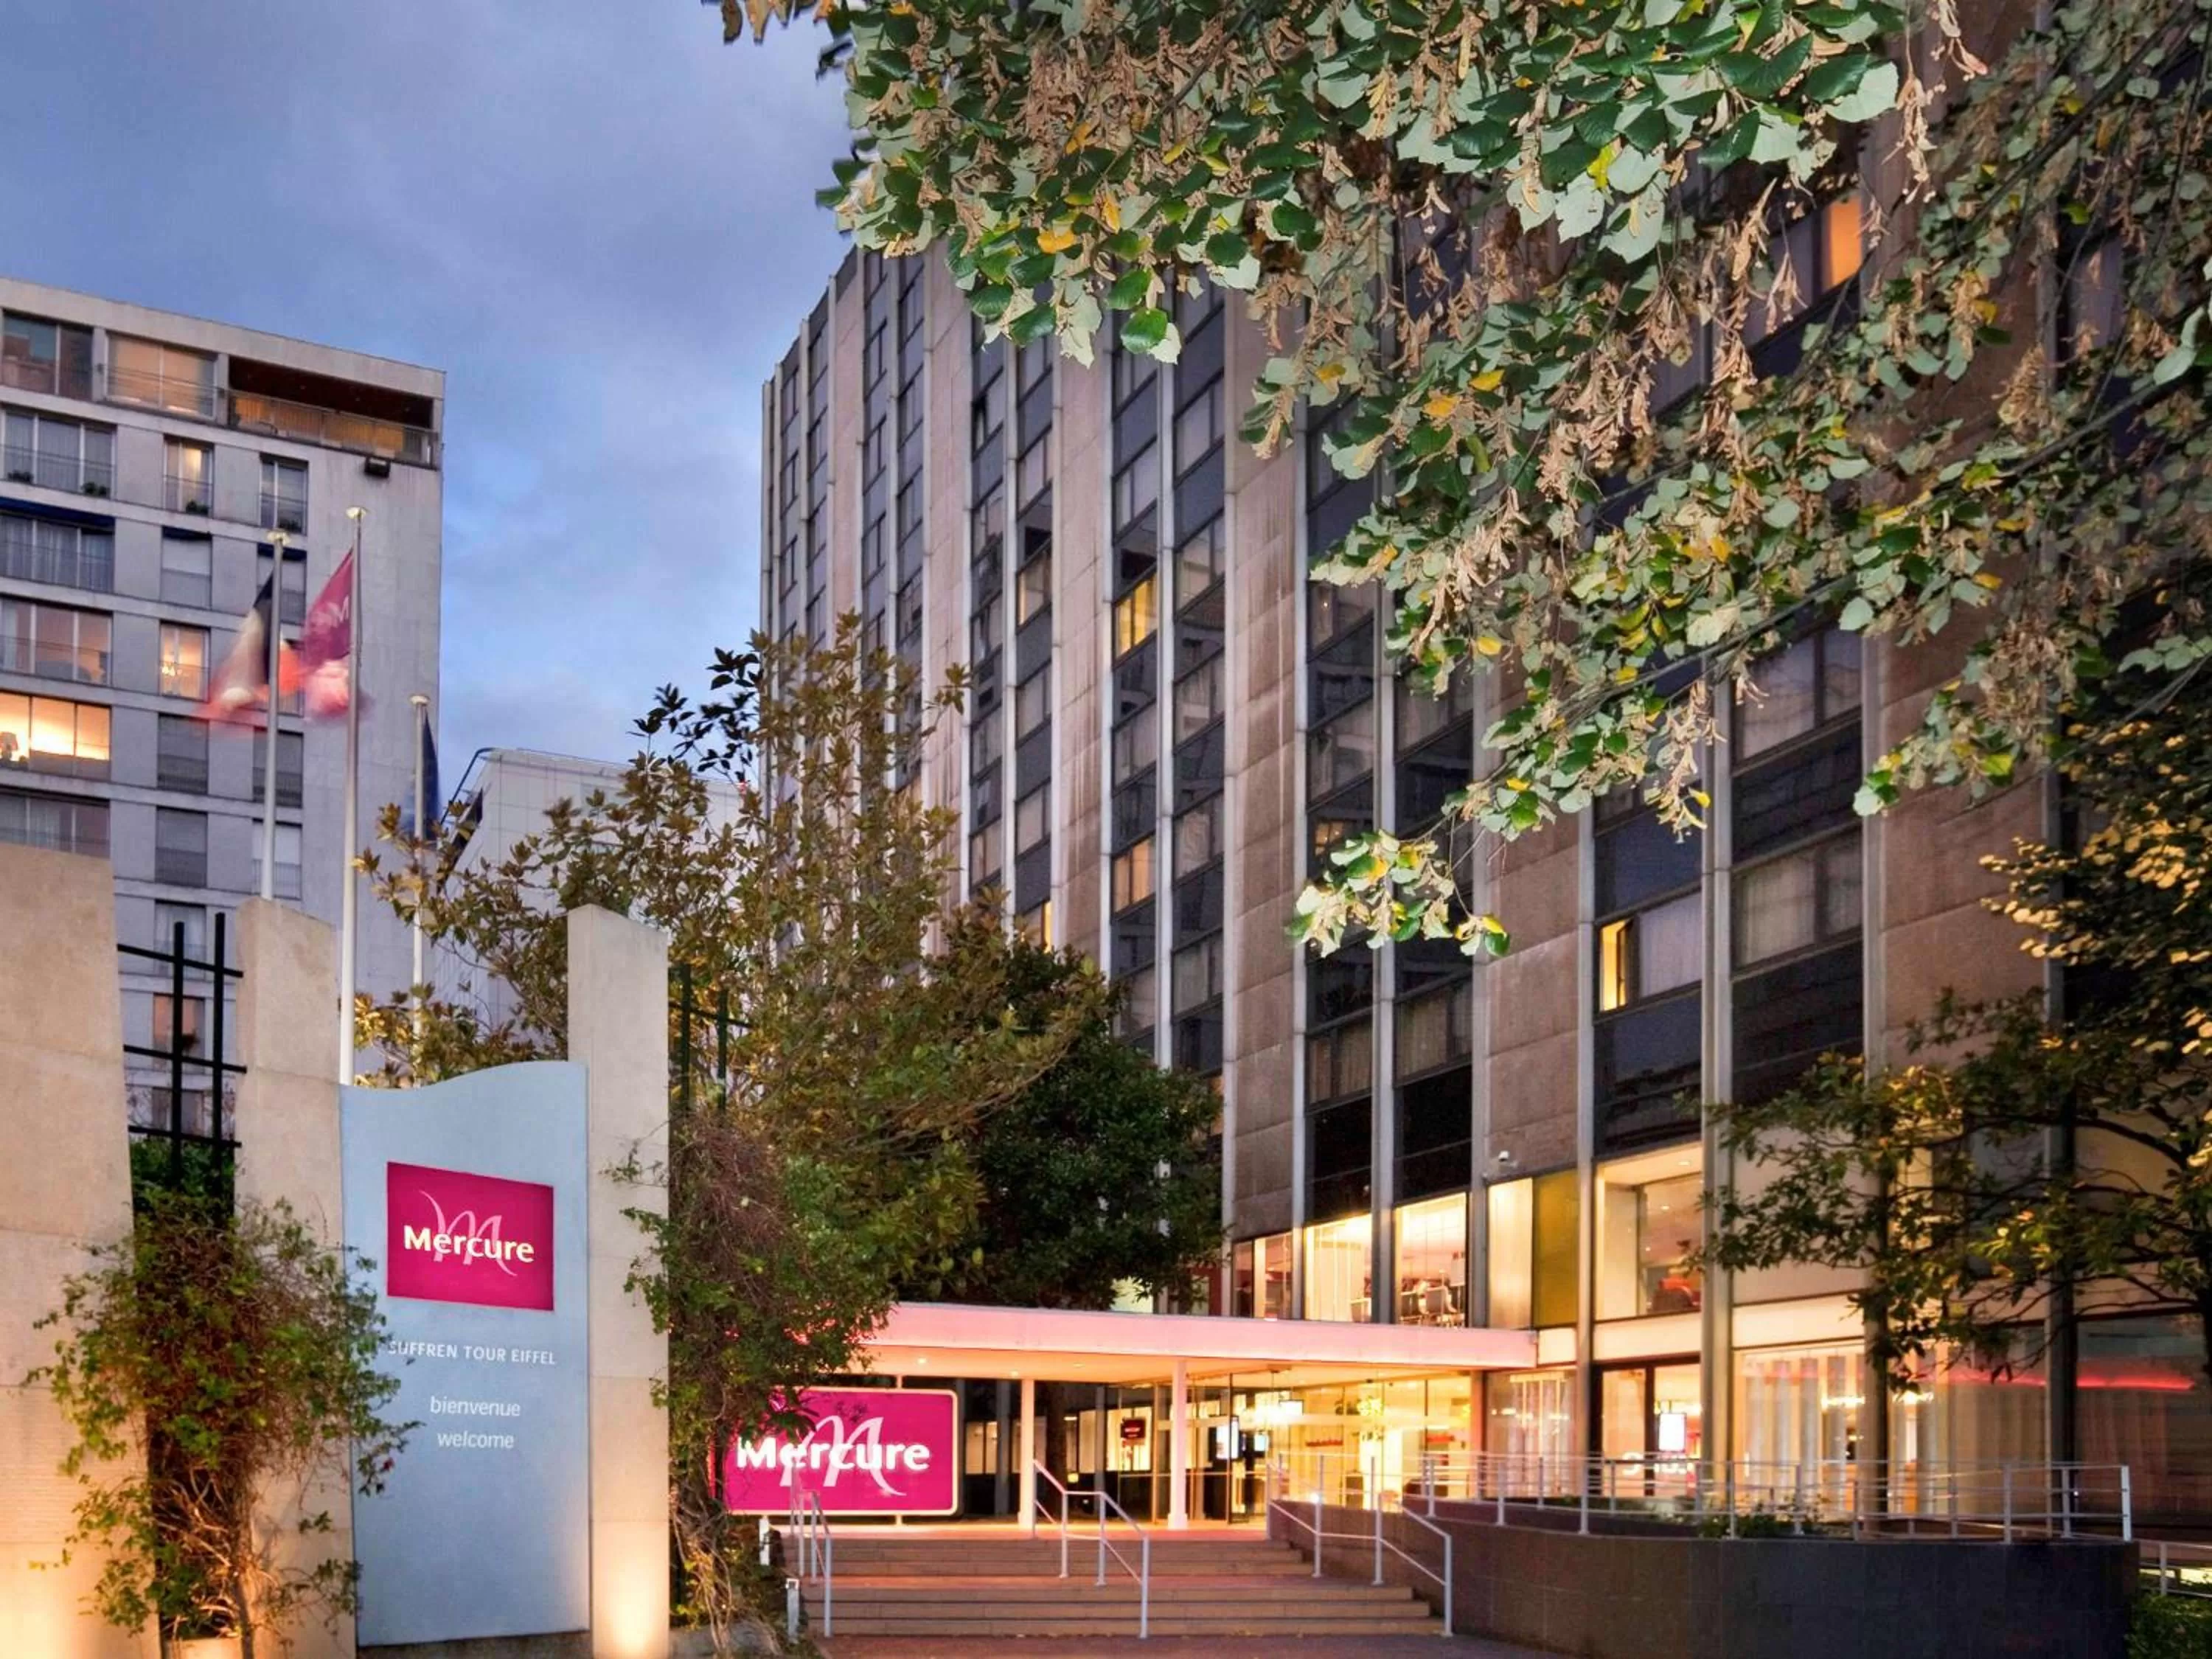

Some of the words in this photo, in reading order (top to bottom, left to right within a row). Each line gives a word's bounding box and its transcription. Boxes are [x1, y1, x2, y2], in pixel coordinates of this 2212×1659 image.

[403, 1225, 535, 1263] Mercure
[388, 1340, 458, 1358] SUFFREN
[464, 1345, 507, 1362] TOUR
[511, 1349, 555, 1365] EIFFEL
[430, 1395, 521, 1416] bienvenue
[437, 1430, 514, 1449] welcome
[737, 1436, 931, 1471] Mercure
